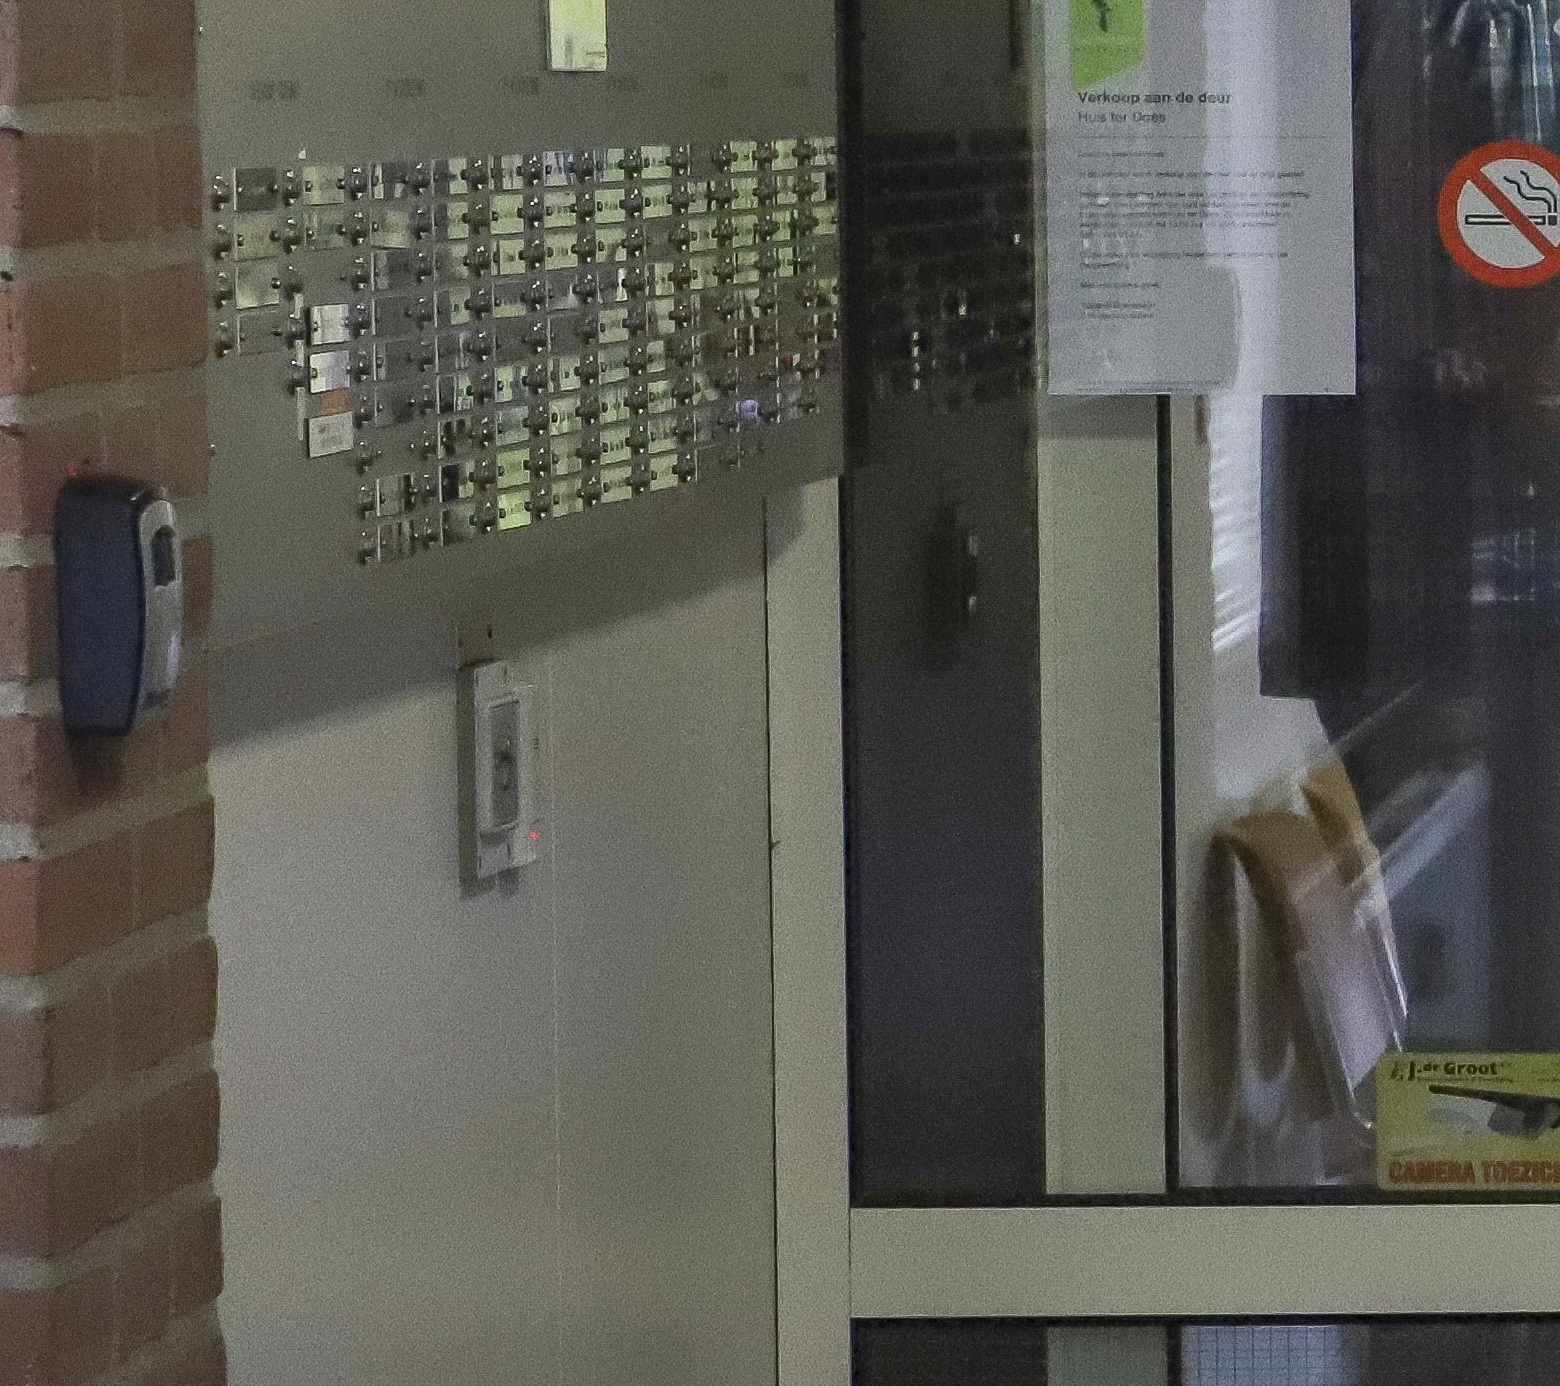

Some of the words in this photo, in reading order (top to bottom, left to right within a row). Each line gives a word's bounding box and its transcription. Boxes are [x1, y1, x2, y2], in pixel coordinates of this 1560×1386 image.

[1077, 90, 1140, 105] Verkoop
[1144, 93, 1171, 104] aan
[1175, 91, 1194, 104] de
[1198, 91, 1232, 104] deur
[1443, 1060, 1498, 1076] Groot
[1388, 1160, 1476, 1184] CAMERA
